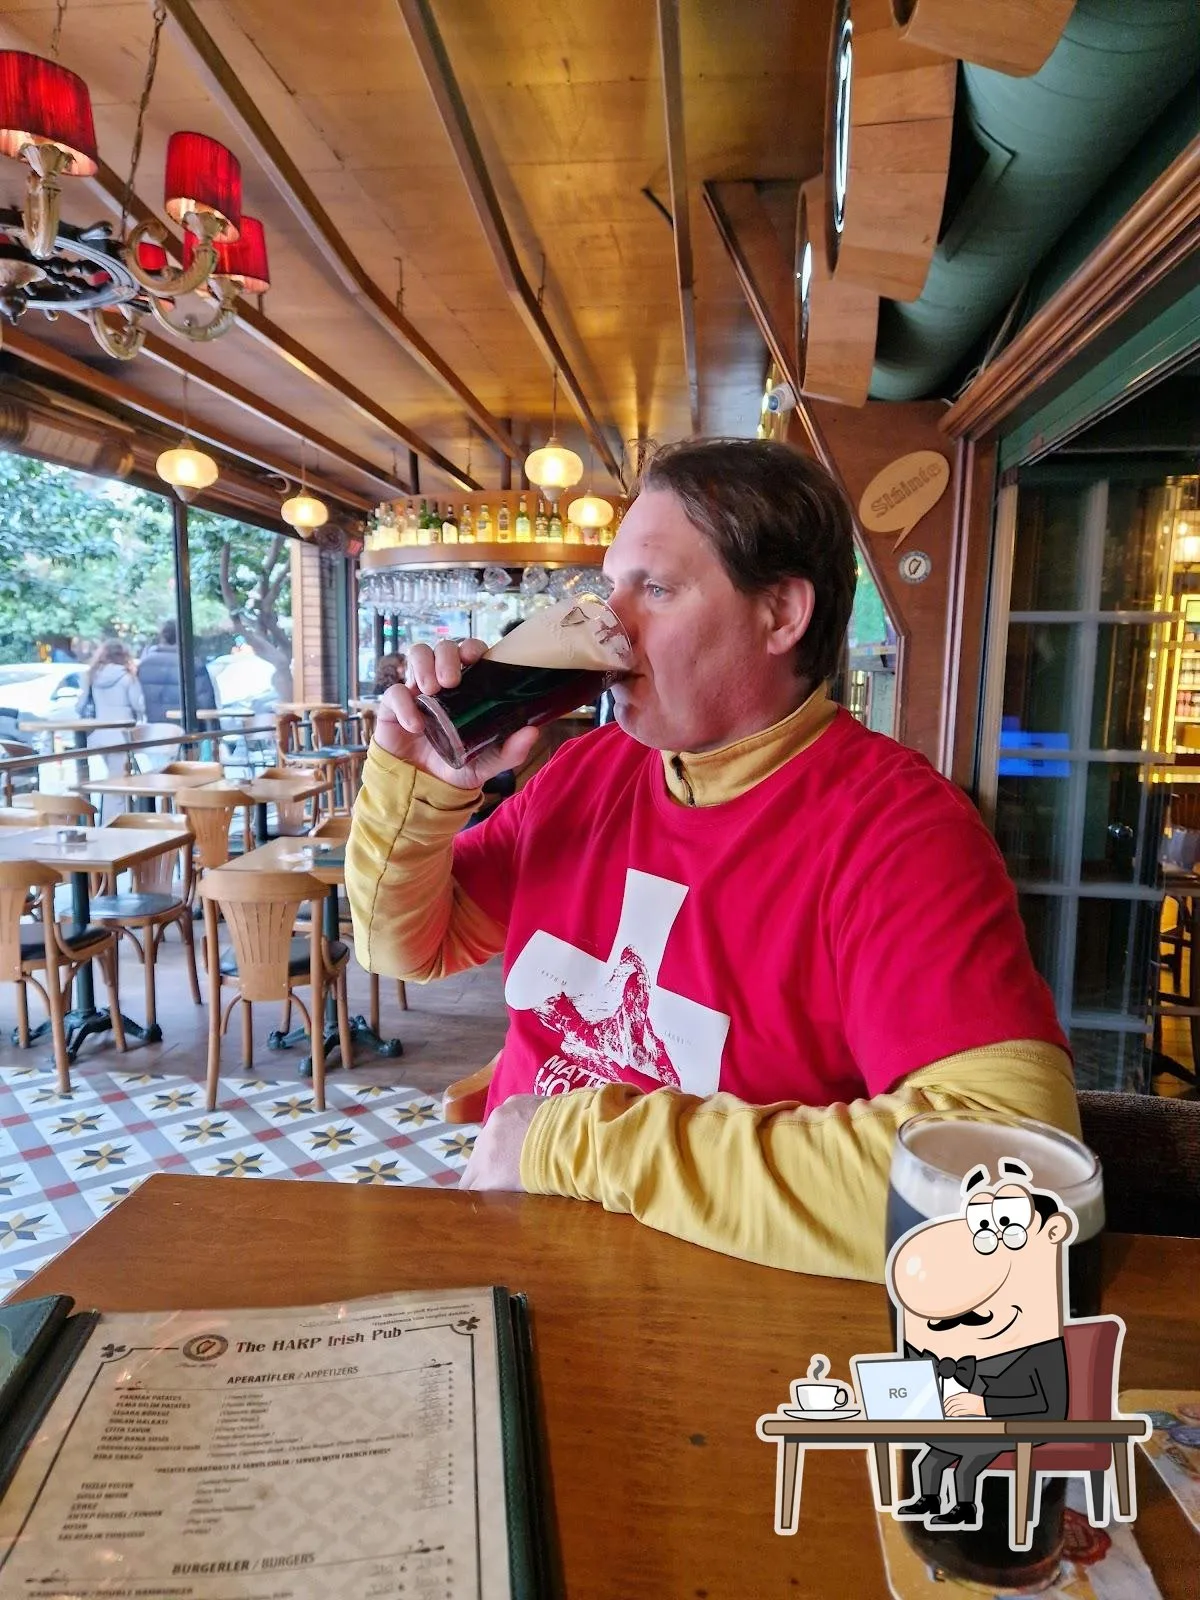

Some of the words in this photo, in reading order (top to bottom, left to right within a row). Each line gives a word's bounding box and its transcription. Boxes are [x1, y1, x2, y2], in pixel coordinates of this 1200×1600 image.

[236, 1341, 266, 1353] The
[272, 1337, 321, 1352] HARP
[327, 1333, 365, 1347] Irish
[372, 1326, 402, 1341] Pub
[304, 1366, 359, 1380] APPETIZERS
[172, 1559, 250, 1576] BURGERLER
[261, 1551, 315, 1569] BURGERS
